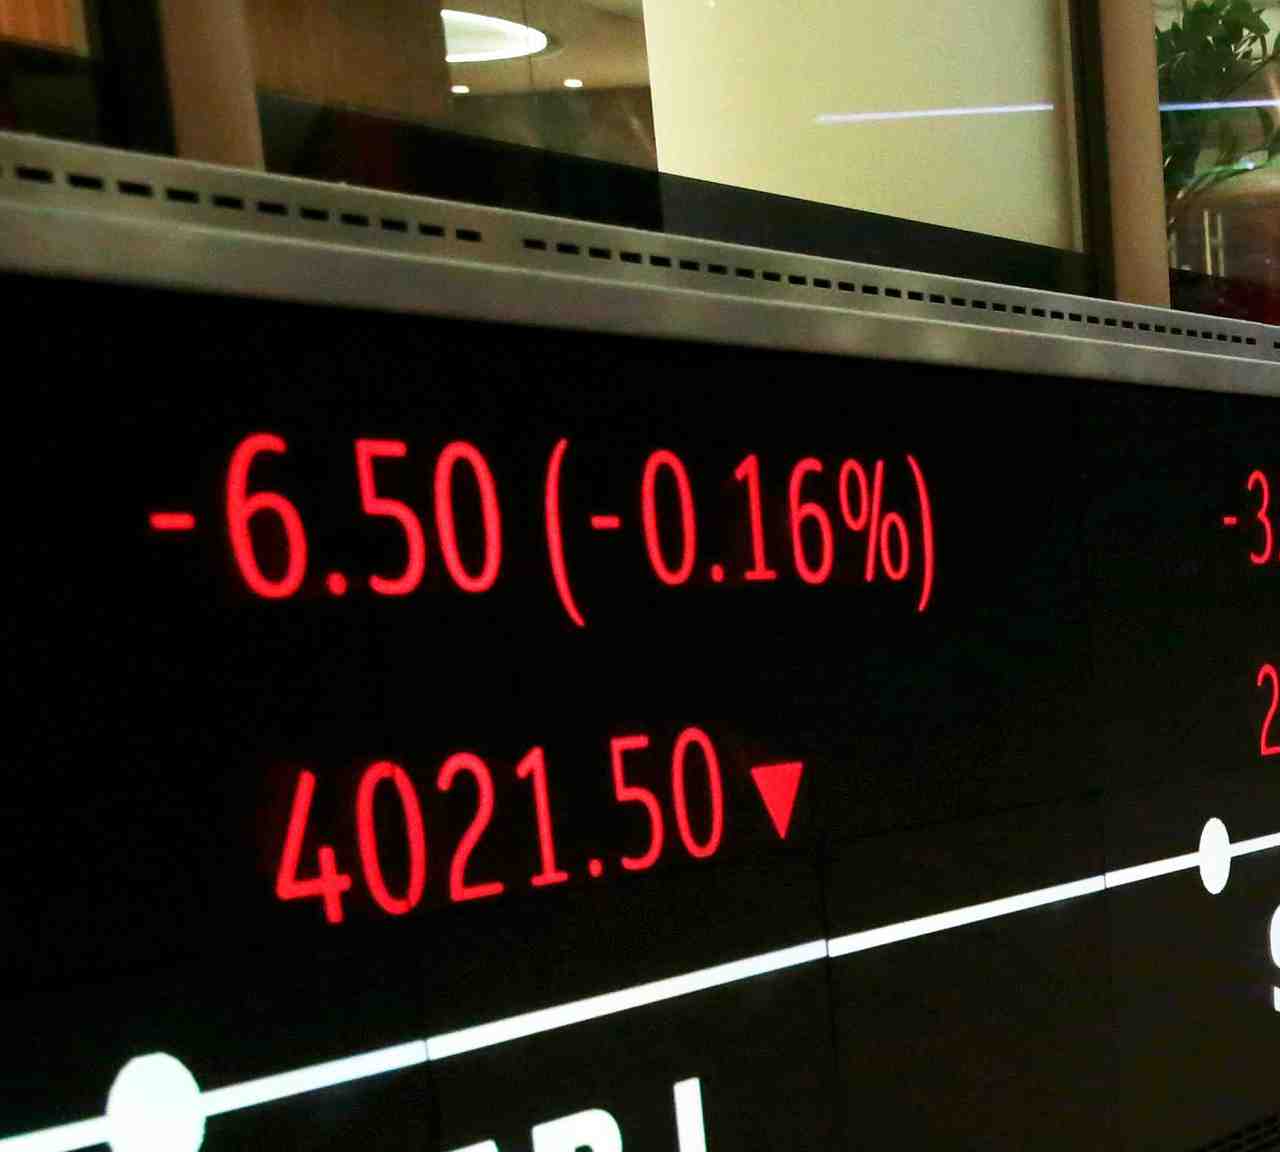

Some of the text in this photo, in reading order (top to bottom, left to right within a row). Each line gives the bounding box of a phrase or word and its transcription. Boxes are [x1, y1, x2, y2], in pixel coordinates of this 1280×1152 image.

[150, 433, 934, 626] -6.50 (-0.16%)
[276, 727, 723, 923] 4021.50
